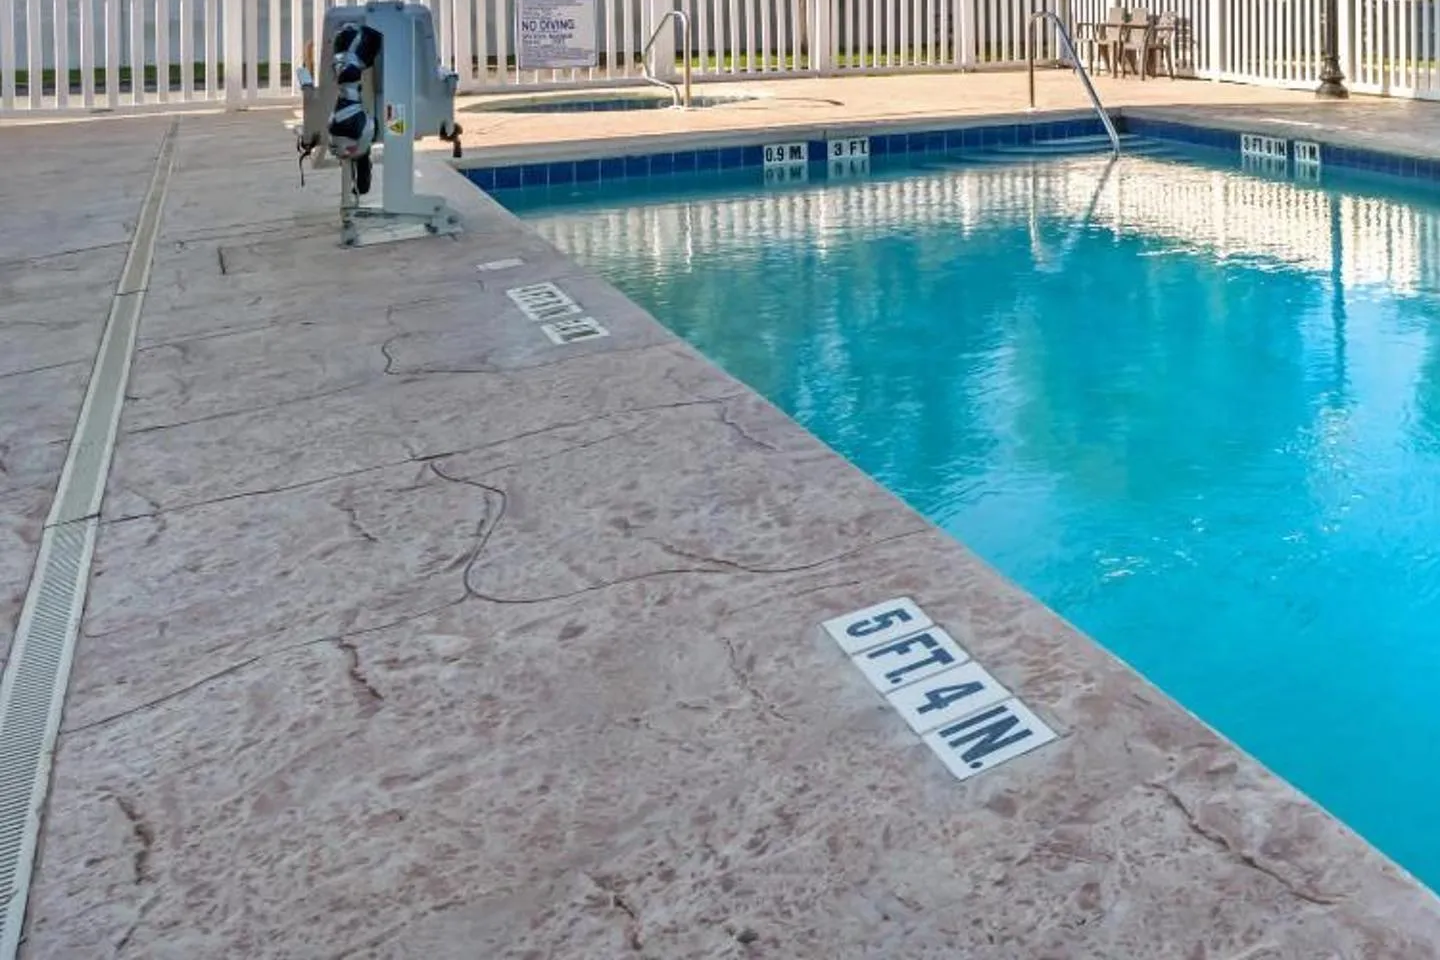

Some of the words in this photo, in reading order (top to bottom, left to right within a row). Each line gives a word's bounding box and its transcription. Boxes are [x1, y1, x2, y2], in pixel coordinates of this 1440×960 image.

[521, 20, 537, 32] NO
[539, 19, 576, 32] DIVING
[765, 146, 785, 163] 0.9
[834, 143, 842, 156] 3
[845, 607, 913, 638] 5
[867, 632, 956, 685] FT.
[917, 680, 987, 715] 4
[938, 704, 1034, 770] IN.
